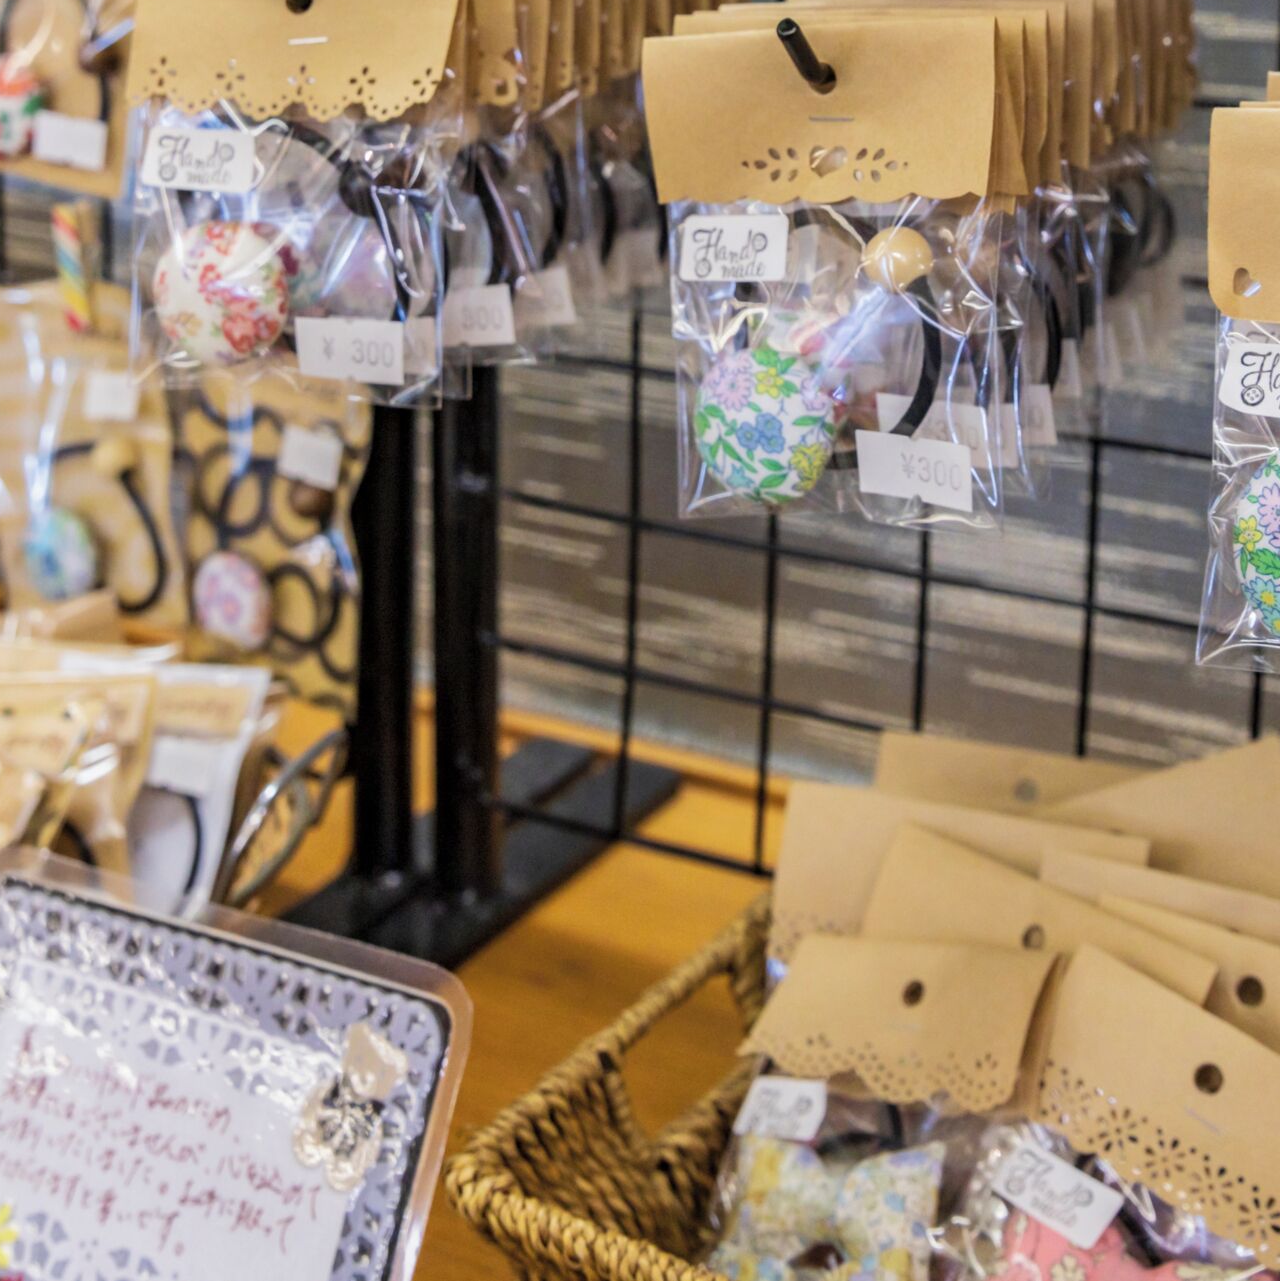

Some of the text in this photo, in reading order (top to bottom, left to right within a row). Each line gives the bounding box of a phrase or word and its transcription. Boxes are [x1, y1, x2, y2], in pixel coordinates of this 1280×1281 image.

[693, 227, 753, 264] Hand
[351, 339, 395, 368] 300
[900, 452, 963, 491] ¥300
